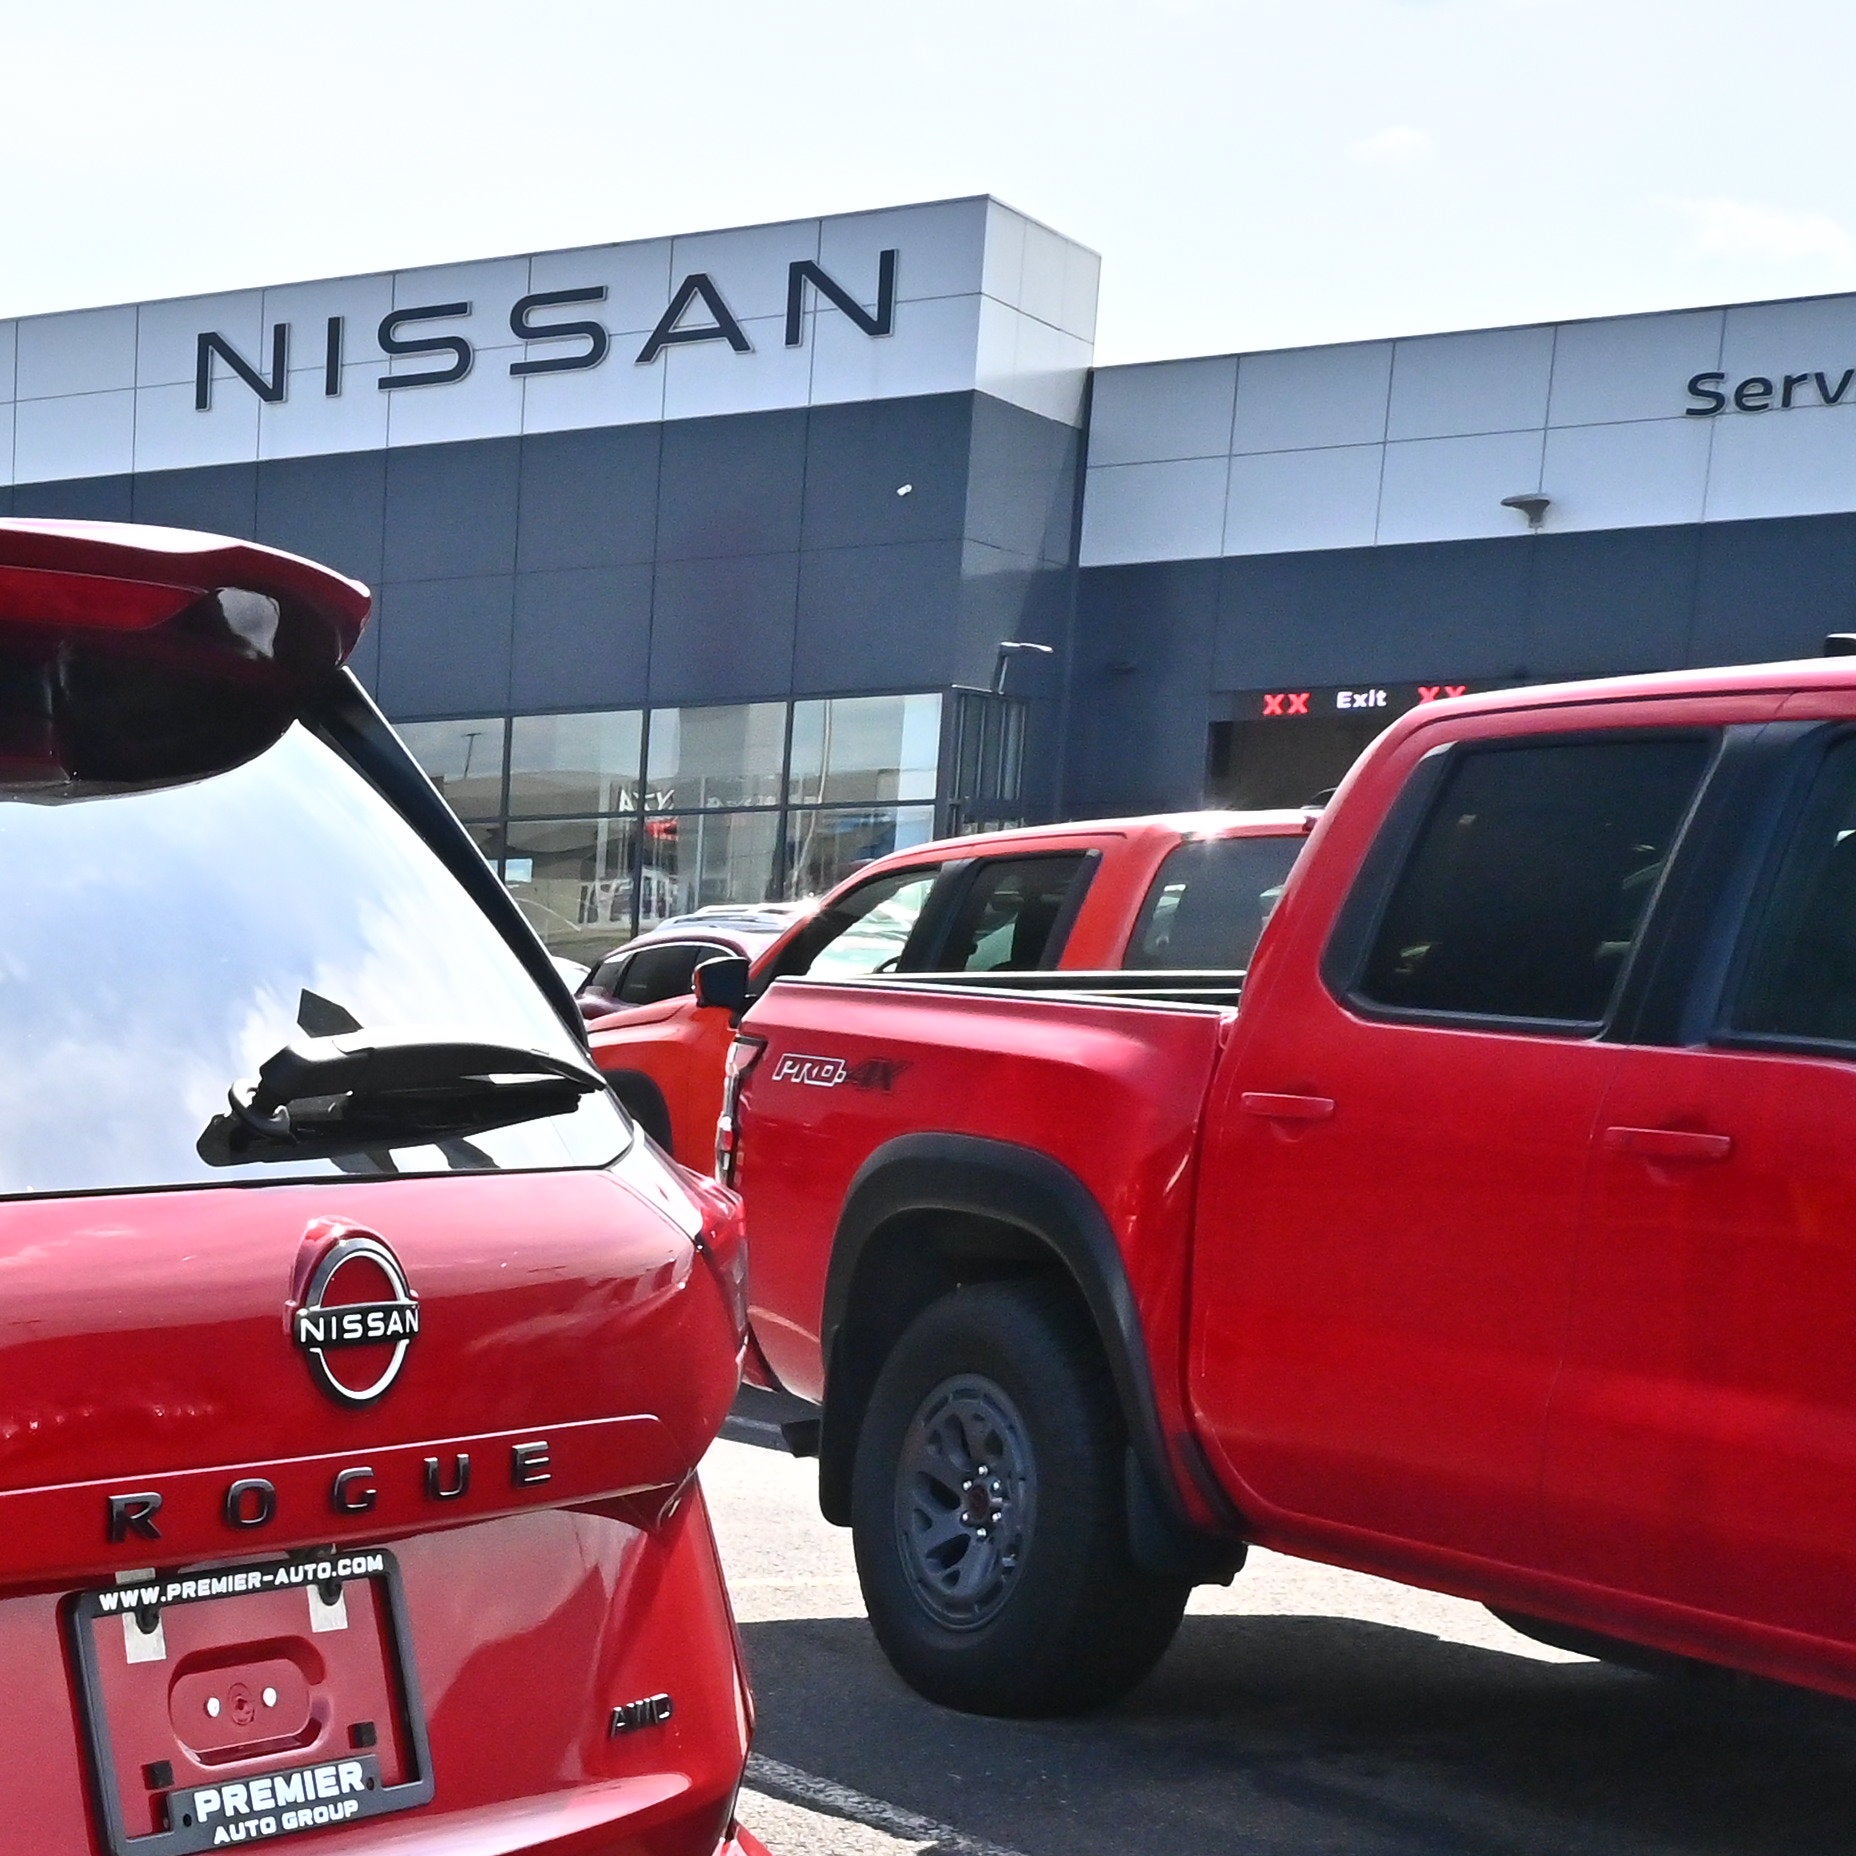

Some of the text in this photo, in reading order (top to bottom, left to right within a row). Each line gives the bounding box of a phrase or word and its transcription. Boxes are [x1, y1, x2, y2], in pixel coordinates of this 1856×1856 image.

[194, 248, 899, 413] NISSAN
[1685, 368, 1856, 417] Serv
[1337, 689, 1388, 709] Exit
[299, 1308, 420, 1343] NISSAN
[106, 1440, 553, 1544] ROGUE
[99, 1553, 385, 1612] WWW.PREMIER-AUTO.COM
[193, 1761, 365, 1824] PREMIER
[214, 1799, 359, 1845] AUTO GROUP
